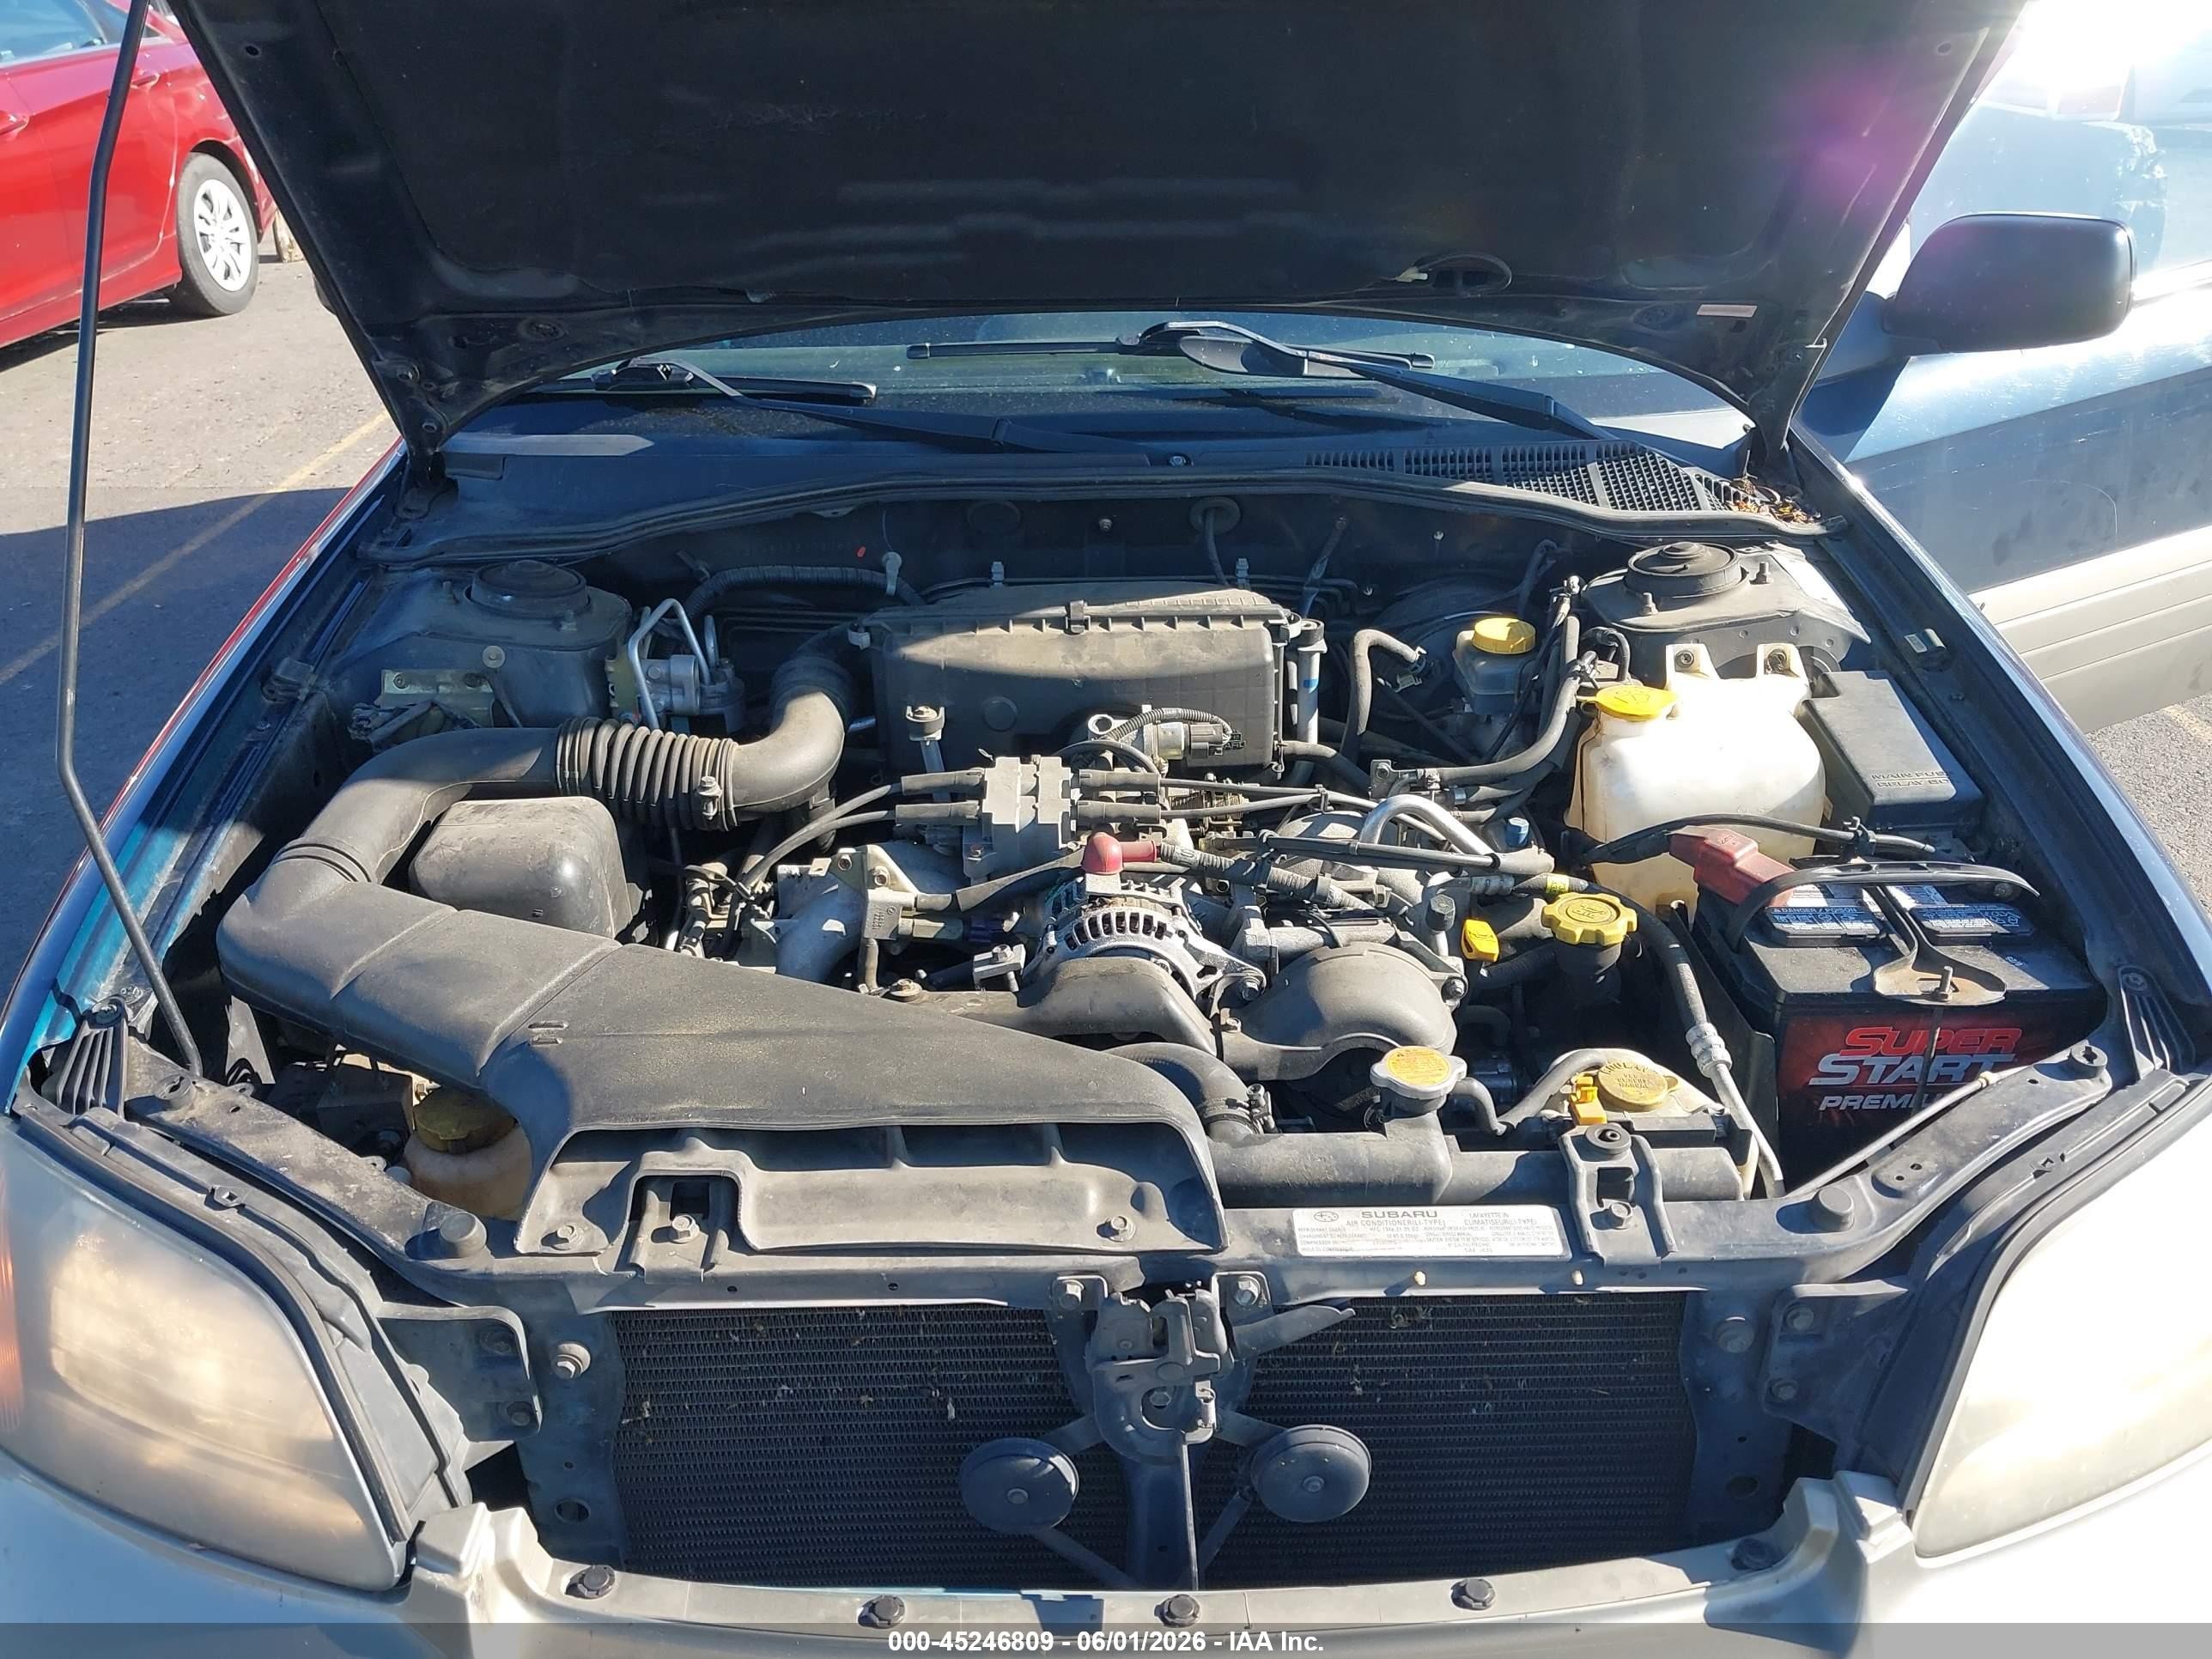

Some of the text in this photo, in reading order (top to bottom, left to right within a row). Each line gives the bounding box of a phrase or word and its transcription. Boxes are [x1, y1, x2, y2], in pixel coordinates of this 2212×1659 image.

[1871, 771, 1913, 780] MAIN
[1876, 779, 1923, 787] RELAY
[1839, 1026, 2022, 1057] SUPER
[1808, 1051, 2015, 1087] START
[1361, 1210, 1438, 1218] SUBARU
